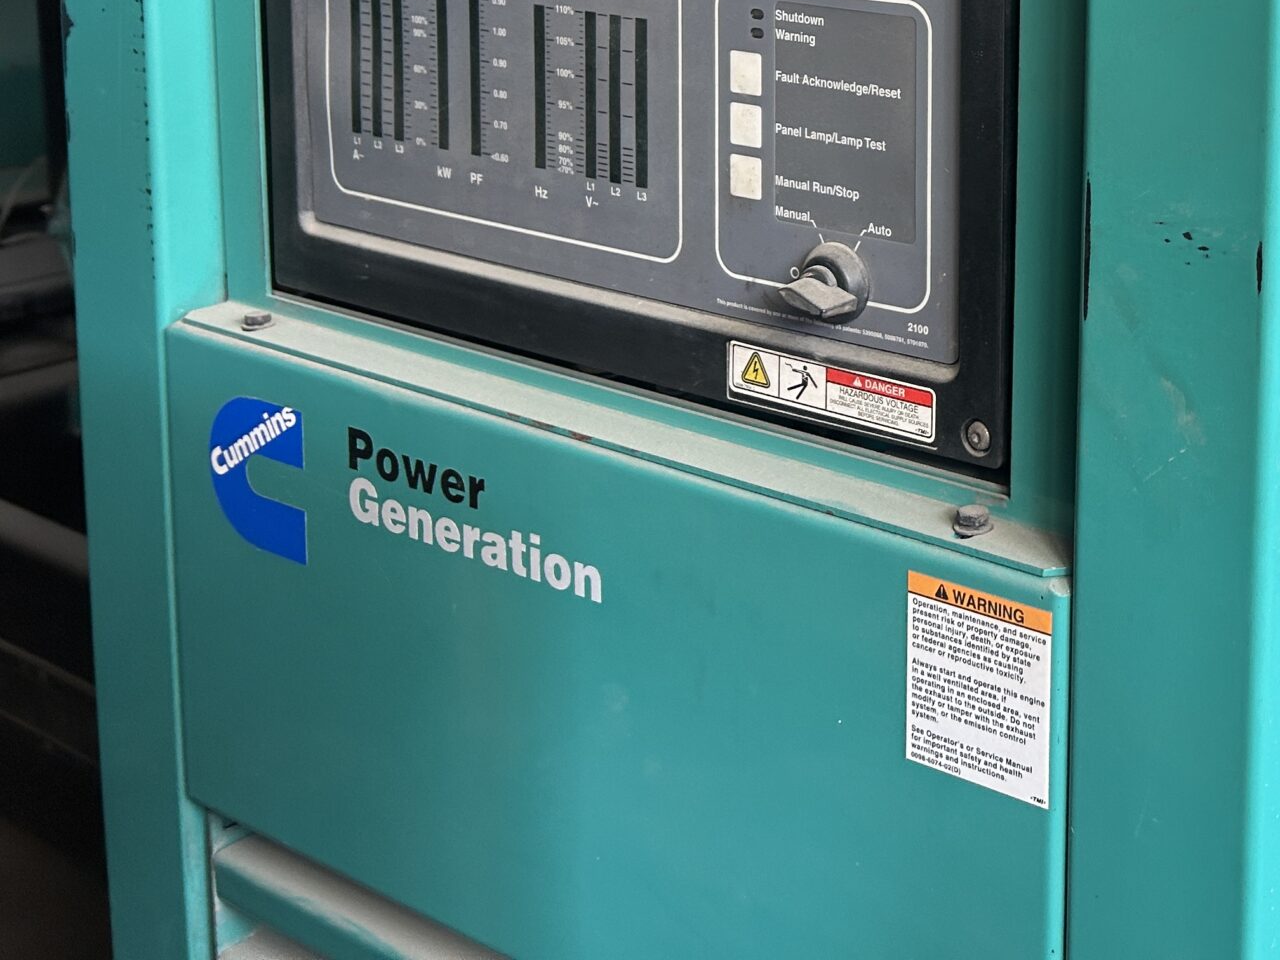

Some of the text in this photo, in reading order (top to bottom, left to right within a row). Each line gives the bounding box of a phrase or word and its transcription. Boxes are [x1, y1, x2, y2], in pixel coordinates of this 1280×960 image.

[556, 5, 574, 15] 110%
[776, 10, 824, 26] Shutdown
[493, 28, 506, 37] 1.00
[556, 37, 574, 46] 105%
[776, 29, 815, 47] Warning
[493, 58, 507, 68] 0.90
[556, 68, 574, 78] 100%
[776, 70, 901, 99] Fault Acknowledge/Reset
[558, 101, 572, 110] 95%
[494, 120, 507, 130] 0.70
[354, 136, 361, 145] L1
[395, 144, 404, 154] L3
[416, 137, 426, 146] 0%
[558, 132, 573, 142] 90%
[776, 123, 886, 151] Panel Lamp/Lamp Test
[558, 145, 573, 154] 80%
[559, 156, 573, 166] 70%
[437, 166, 452, 178] kW
[471, 172, 483, 185] PF
[535, 186, 548, 199] Hz
[587, 182, 647, 201] L1 L2 L3
[776, 175, 859, 201] Manual Run/Stop
[776, 206, 810, 221] Manual
[868, 223, 892, 237] Auto
[908, 322, 928, 335] 2100
[865, 380, 905, 397] DANGER
[840, 387, 918, 413] HAZARDOUS VOLTAGE
[211, 407, 296, 475] Cummins
[348, 426, 485, 509] Power
[349, 477, 601, 603] Generation
[953, 589, 1024, 624] WARNING
[913, 598, 1046, 645] Operation, maintenance, and service
[913, 608, 939, 620] present
[941, 616, 954, 625] risk
[967, 623, 997, 640] property
[1000, 634, 1031, 650] damage,
[913, 616, 943, 630] personal
[945, 625, 968, 639] injury,
[971, 634, 993, 646] death,
[1006, 646, 1040, 661] exposure
[922, 627, 962, 644] substances
[965, 639, 999, 656] identified
[1002, 652, 1010, 661] by
[1013, 657, 1031, 667] state
[912, 642, 935, 654] cancer
[947, 652, 993, 673] reproductive
[996, 668, 1026, 684] toxicity.
[922, 635, 946, 649] federal
[949, 645, 980, 659] agencies
[994, 660, 1023, 675] causing
[911, 733, 1022, 778] for important safety and health
[912, 724, 924, 735] See
[927, 730, 963, 749] Operator's
[976, 747, 1003, 763] Service
[1006, 758, 1032, 773] Manual
[911, 742, 1006, 781] warnings and instructions.
